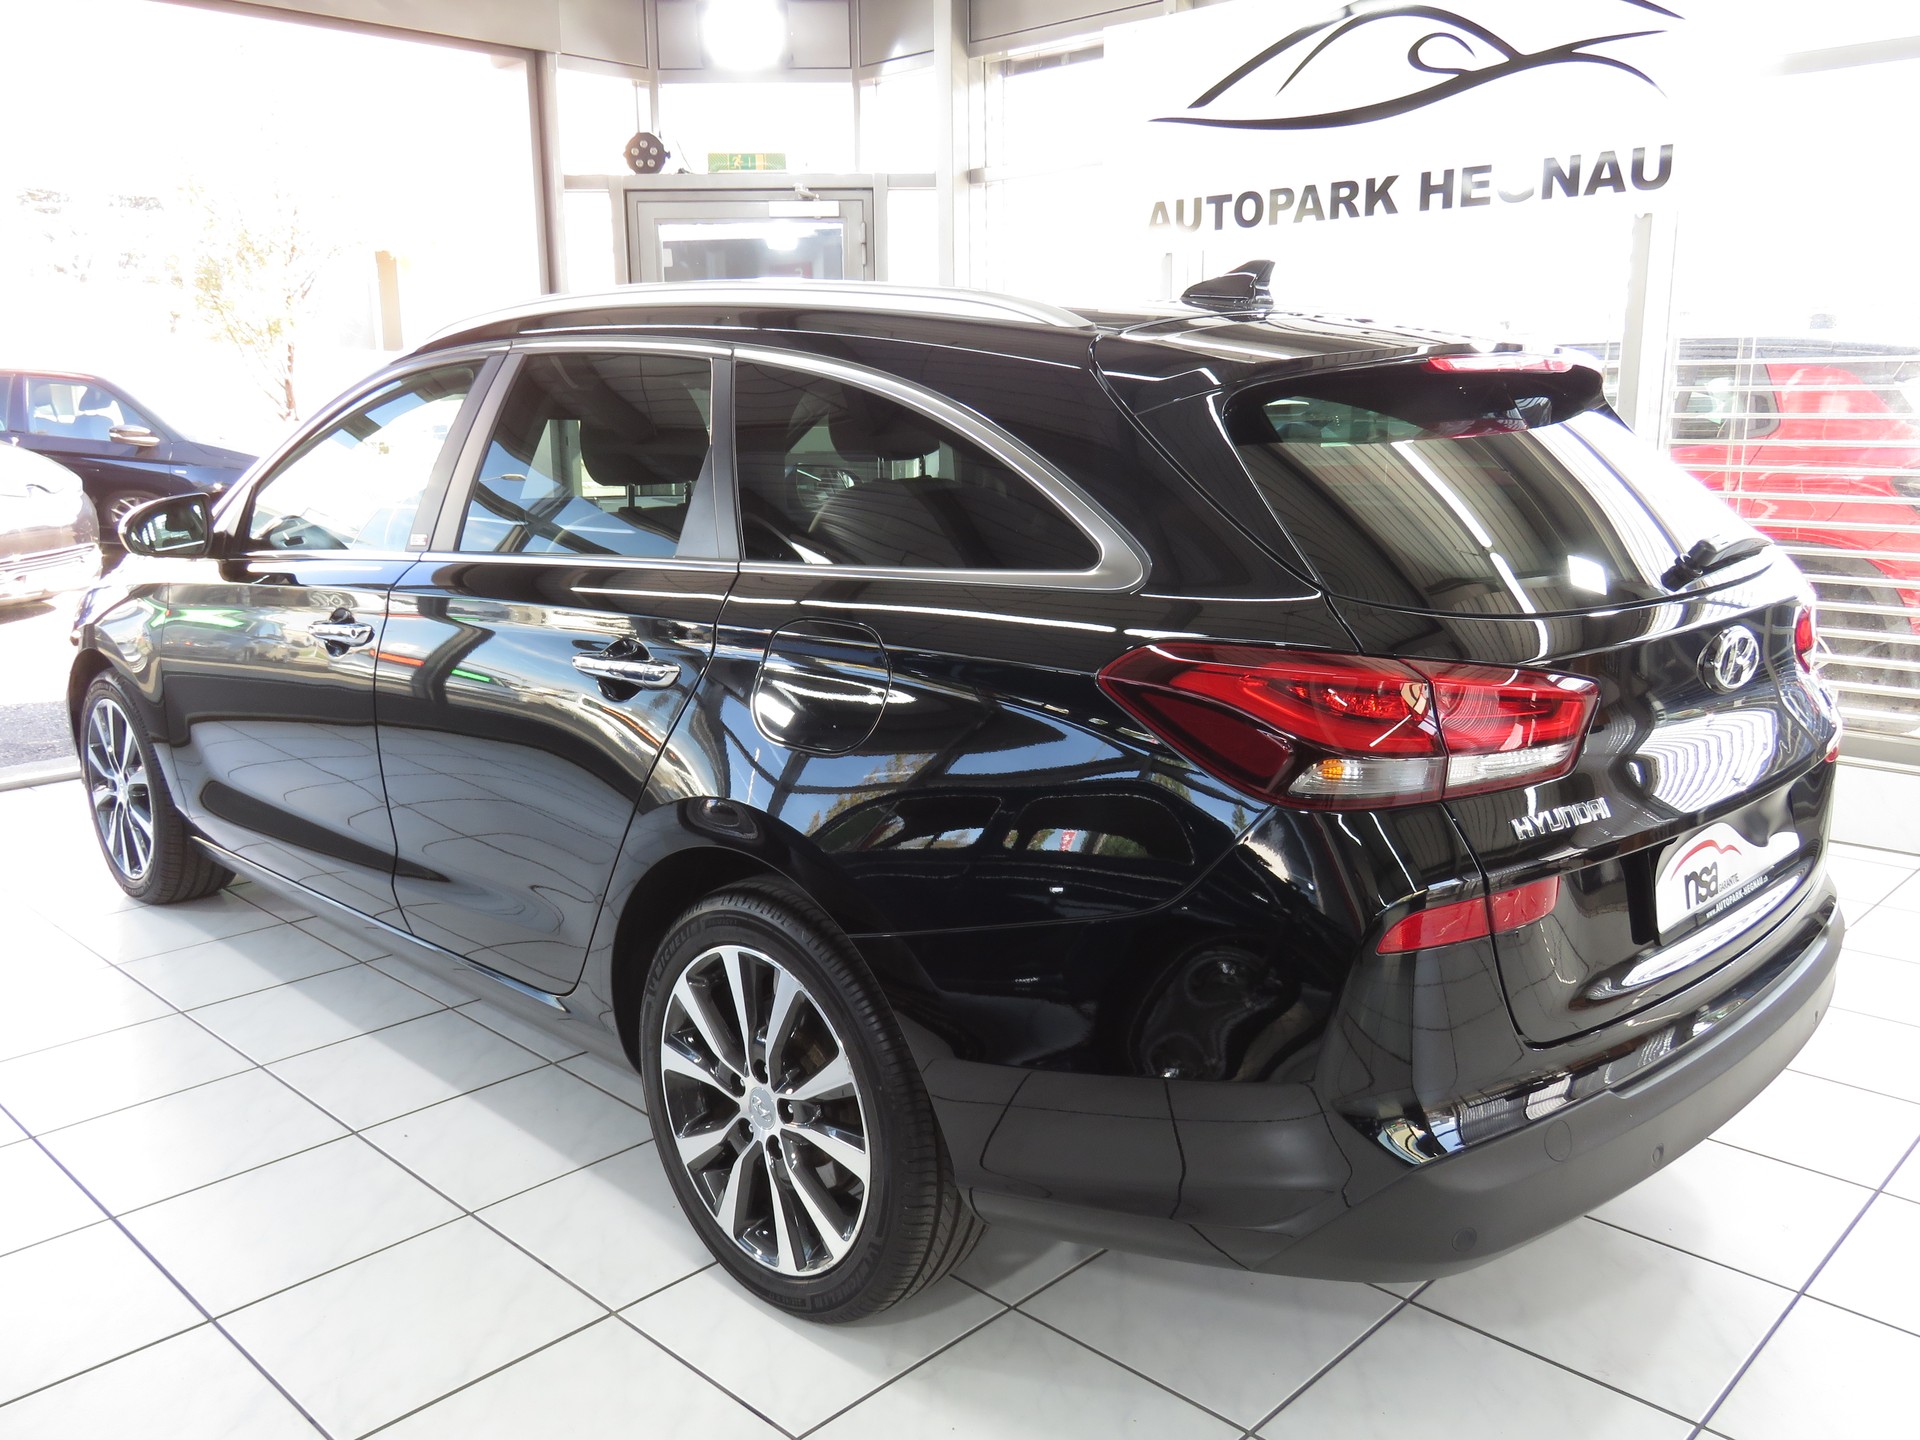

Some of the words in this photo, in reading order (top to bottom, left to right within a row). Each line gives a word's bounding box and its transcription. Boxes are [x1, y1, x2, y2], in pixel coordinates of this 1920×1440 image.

[1149, 175, 1400, 233] AUTOPARK
[1510, 796, 1612, 840] HYUNDAI
[1684, 861, 1718, 910] nsa
